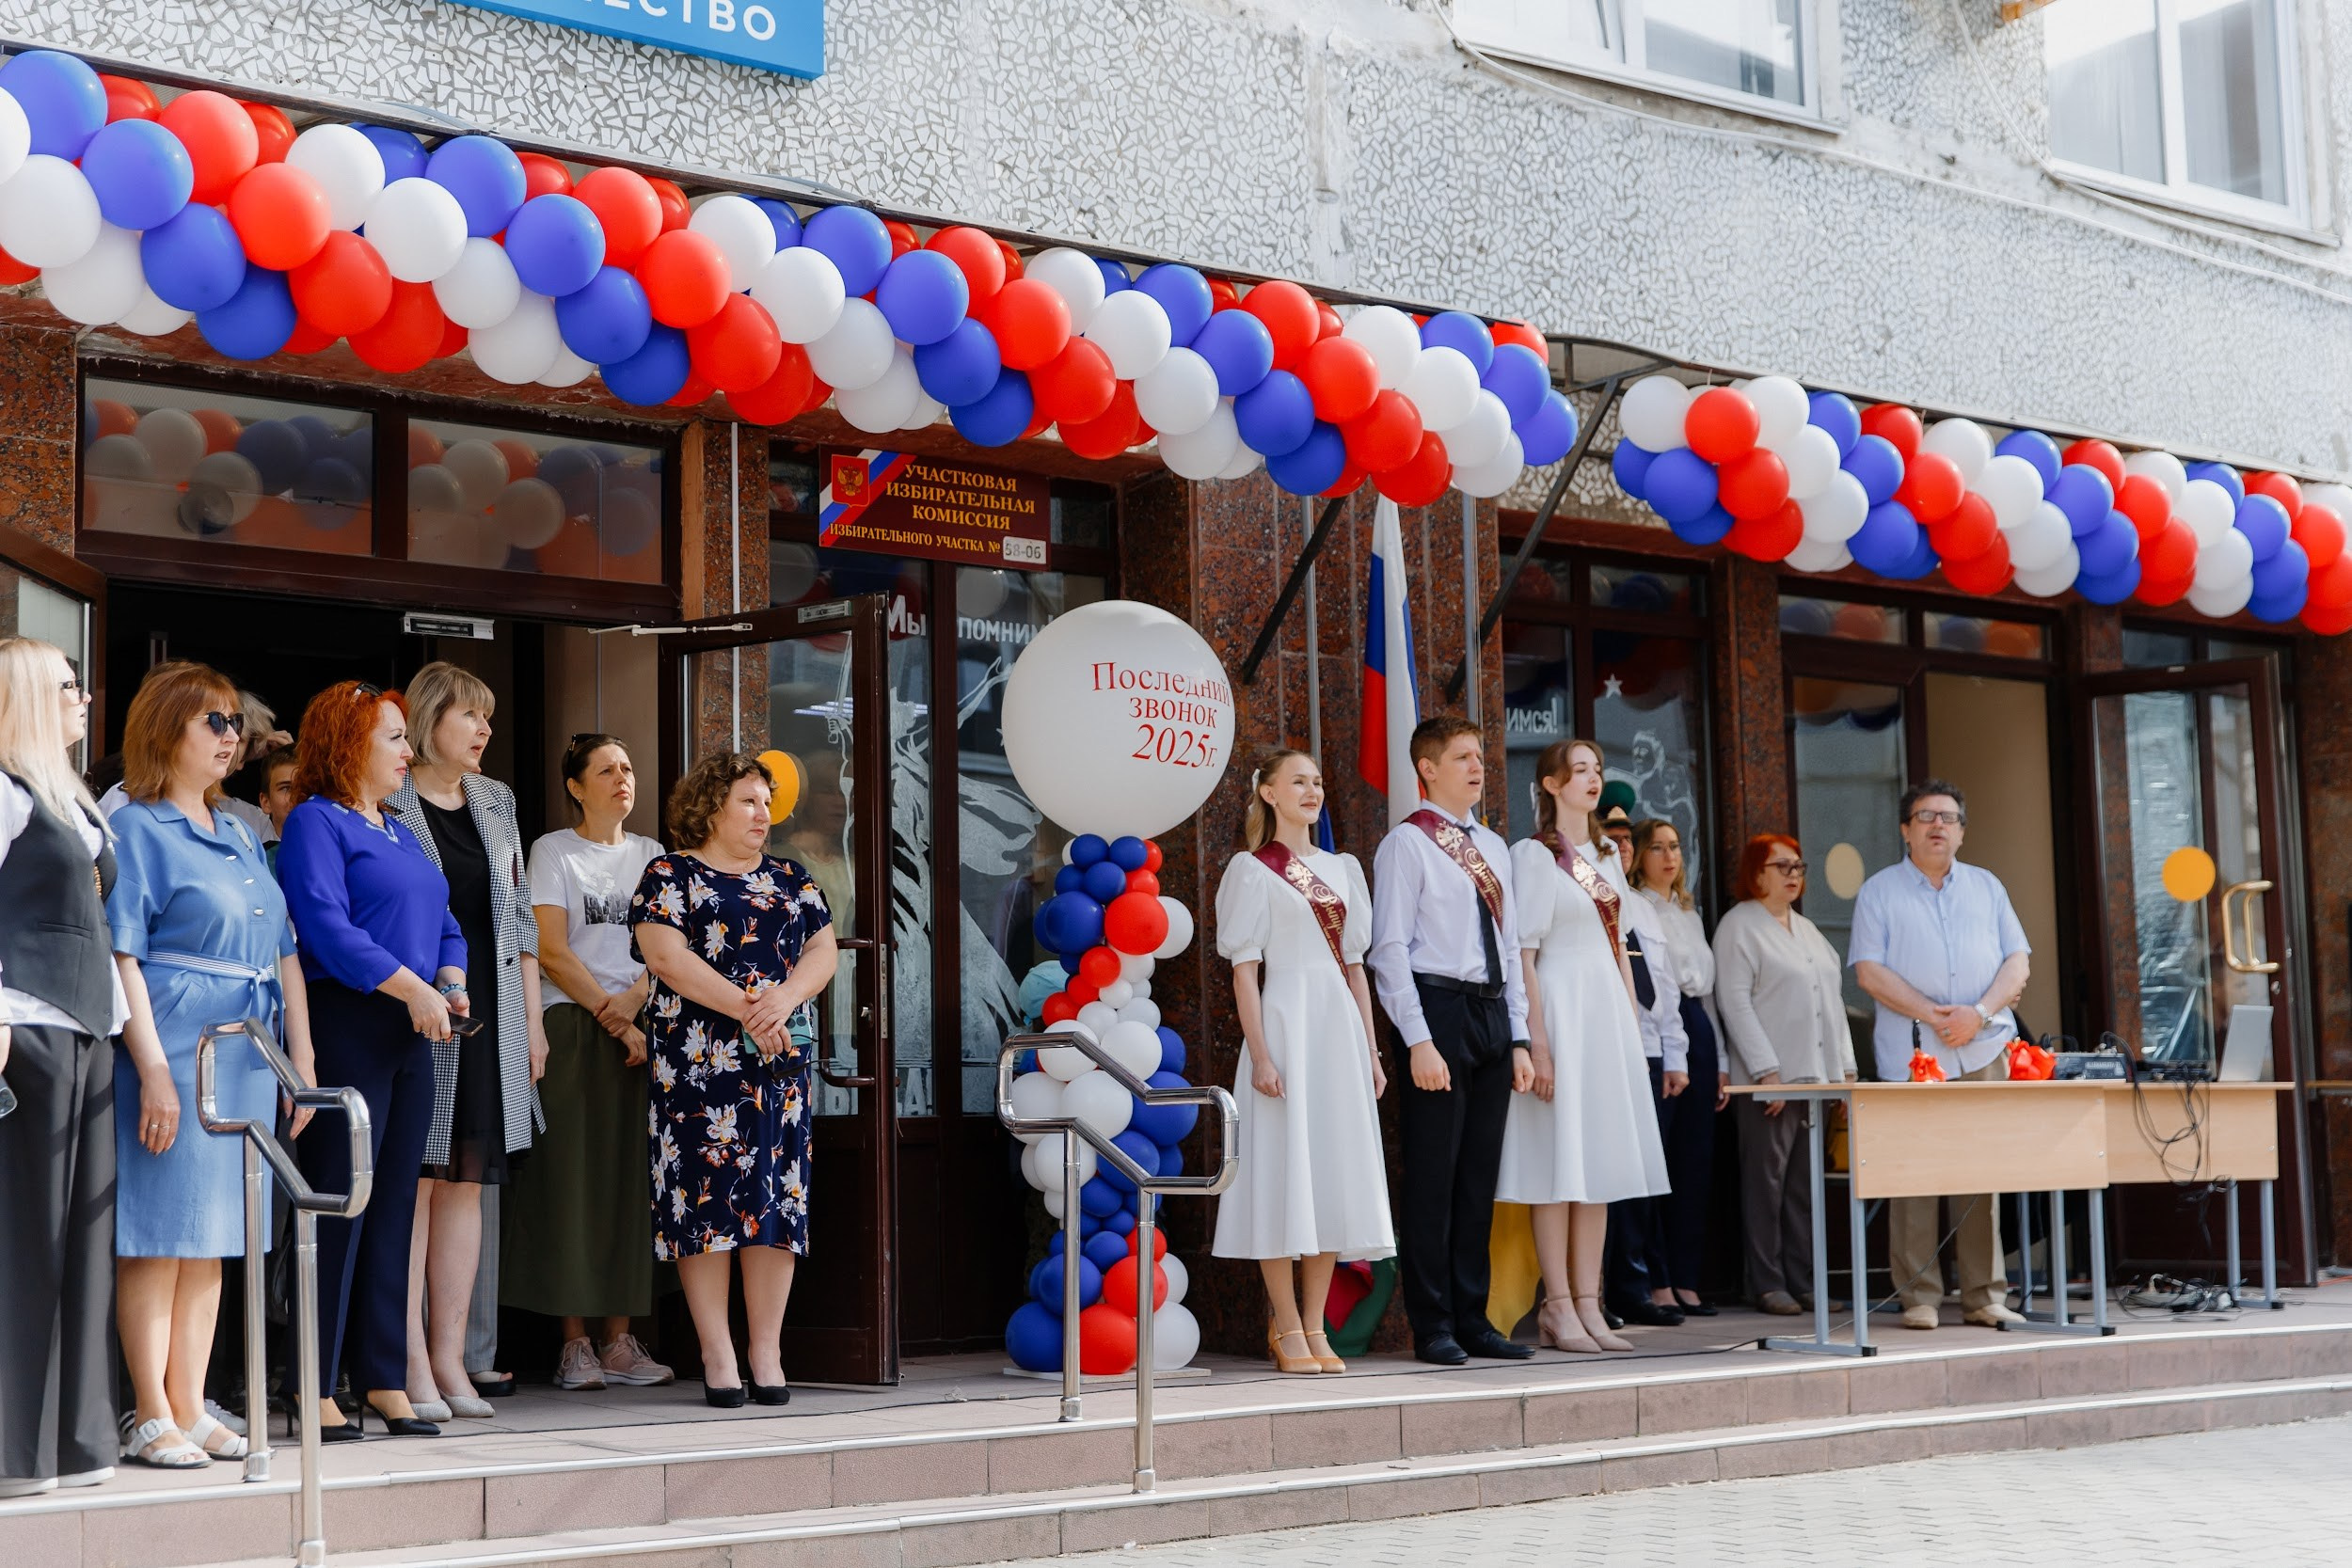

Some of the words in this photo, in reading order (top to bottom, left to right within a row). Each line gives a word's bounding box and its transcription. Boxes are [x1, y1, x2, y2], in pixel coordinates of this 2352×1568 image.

[905, 464, 1017, 492] УЧАСТКОВАЯ
[885, 482, 1036, 514] ИЗБИРАТЕЛЬНАЯ
[912, 504, 1010, 531] КОМИССИЯ
[830, 522, 932, 546] ИЗБИРАТЕЛЬНОГО
[936, 535, 984, 553] УЧАСТКА
[1005, 543, 1041, 560] 58-06
[958, 614, 1054, 644] помни
[1091, 661, 1231, 707] Последний
[1129, 697, 1217, 729] звонок
[1132, 723, 1218, 768] 2025г.
